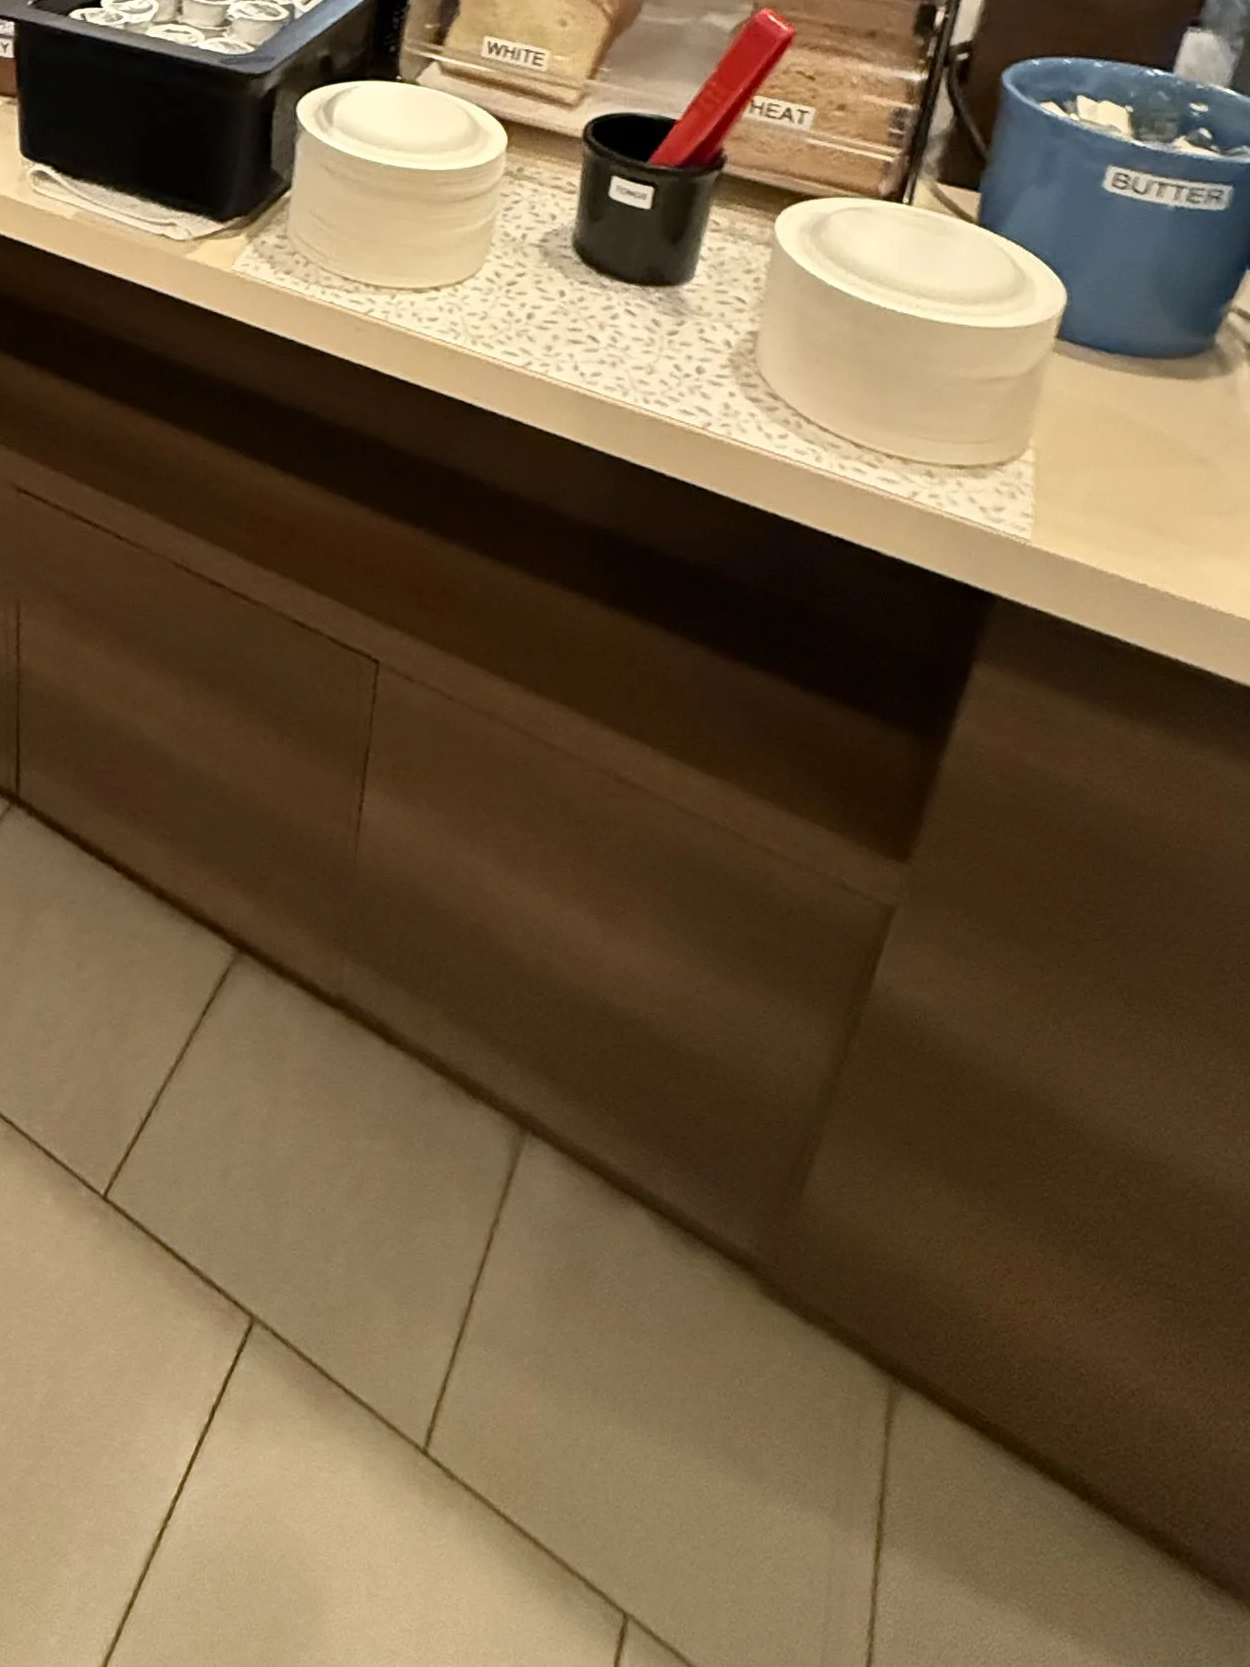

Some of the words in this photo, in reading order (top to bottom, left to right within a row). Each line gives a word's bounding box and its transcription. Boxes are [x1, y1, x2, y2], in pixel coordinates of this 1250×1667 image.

[486, 40, 546, 67] WHITE
[750, 99, 810, 126] HEAT
[1111, 171, 1226, 205] BUTTER
